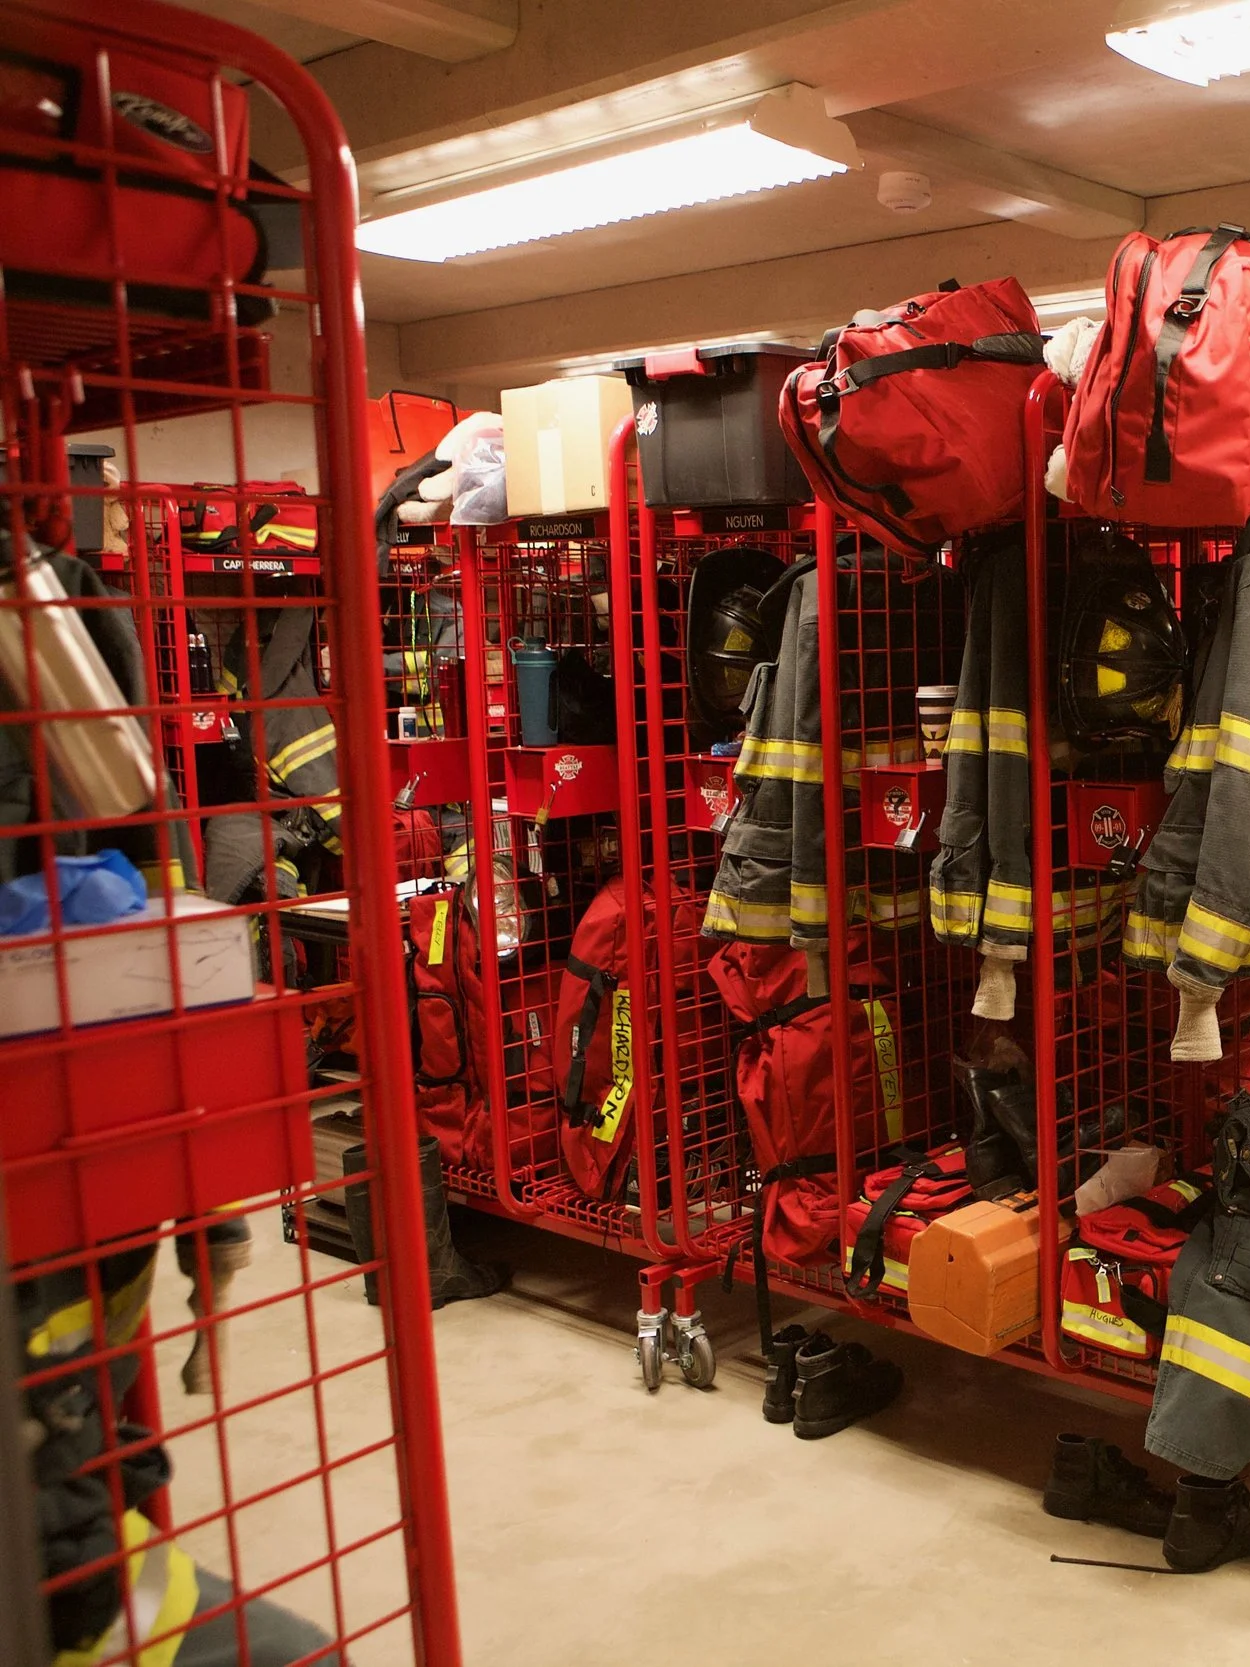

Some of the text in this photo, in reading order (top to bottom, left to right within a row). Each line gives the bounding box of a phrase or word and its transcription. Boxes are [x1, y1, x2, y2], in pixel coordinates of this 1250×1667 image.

[725, 514, 764, 529] NGUYEN
[529, 522, 582, 537] RICHARDSON
[248, 560, 286, 571] HERRERA
[1089, 1308, 1123, 1327] HUGHES
